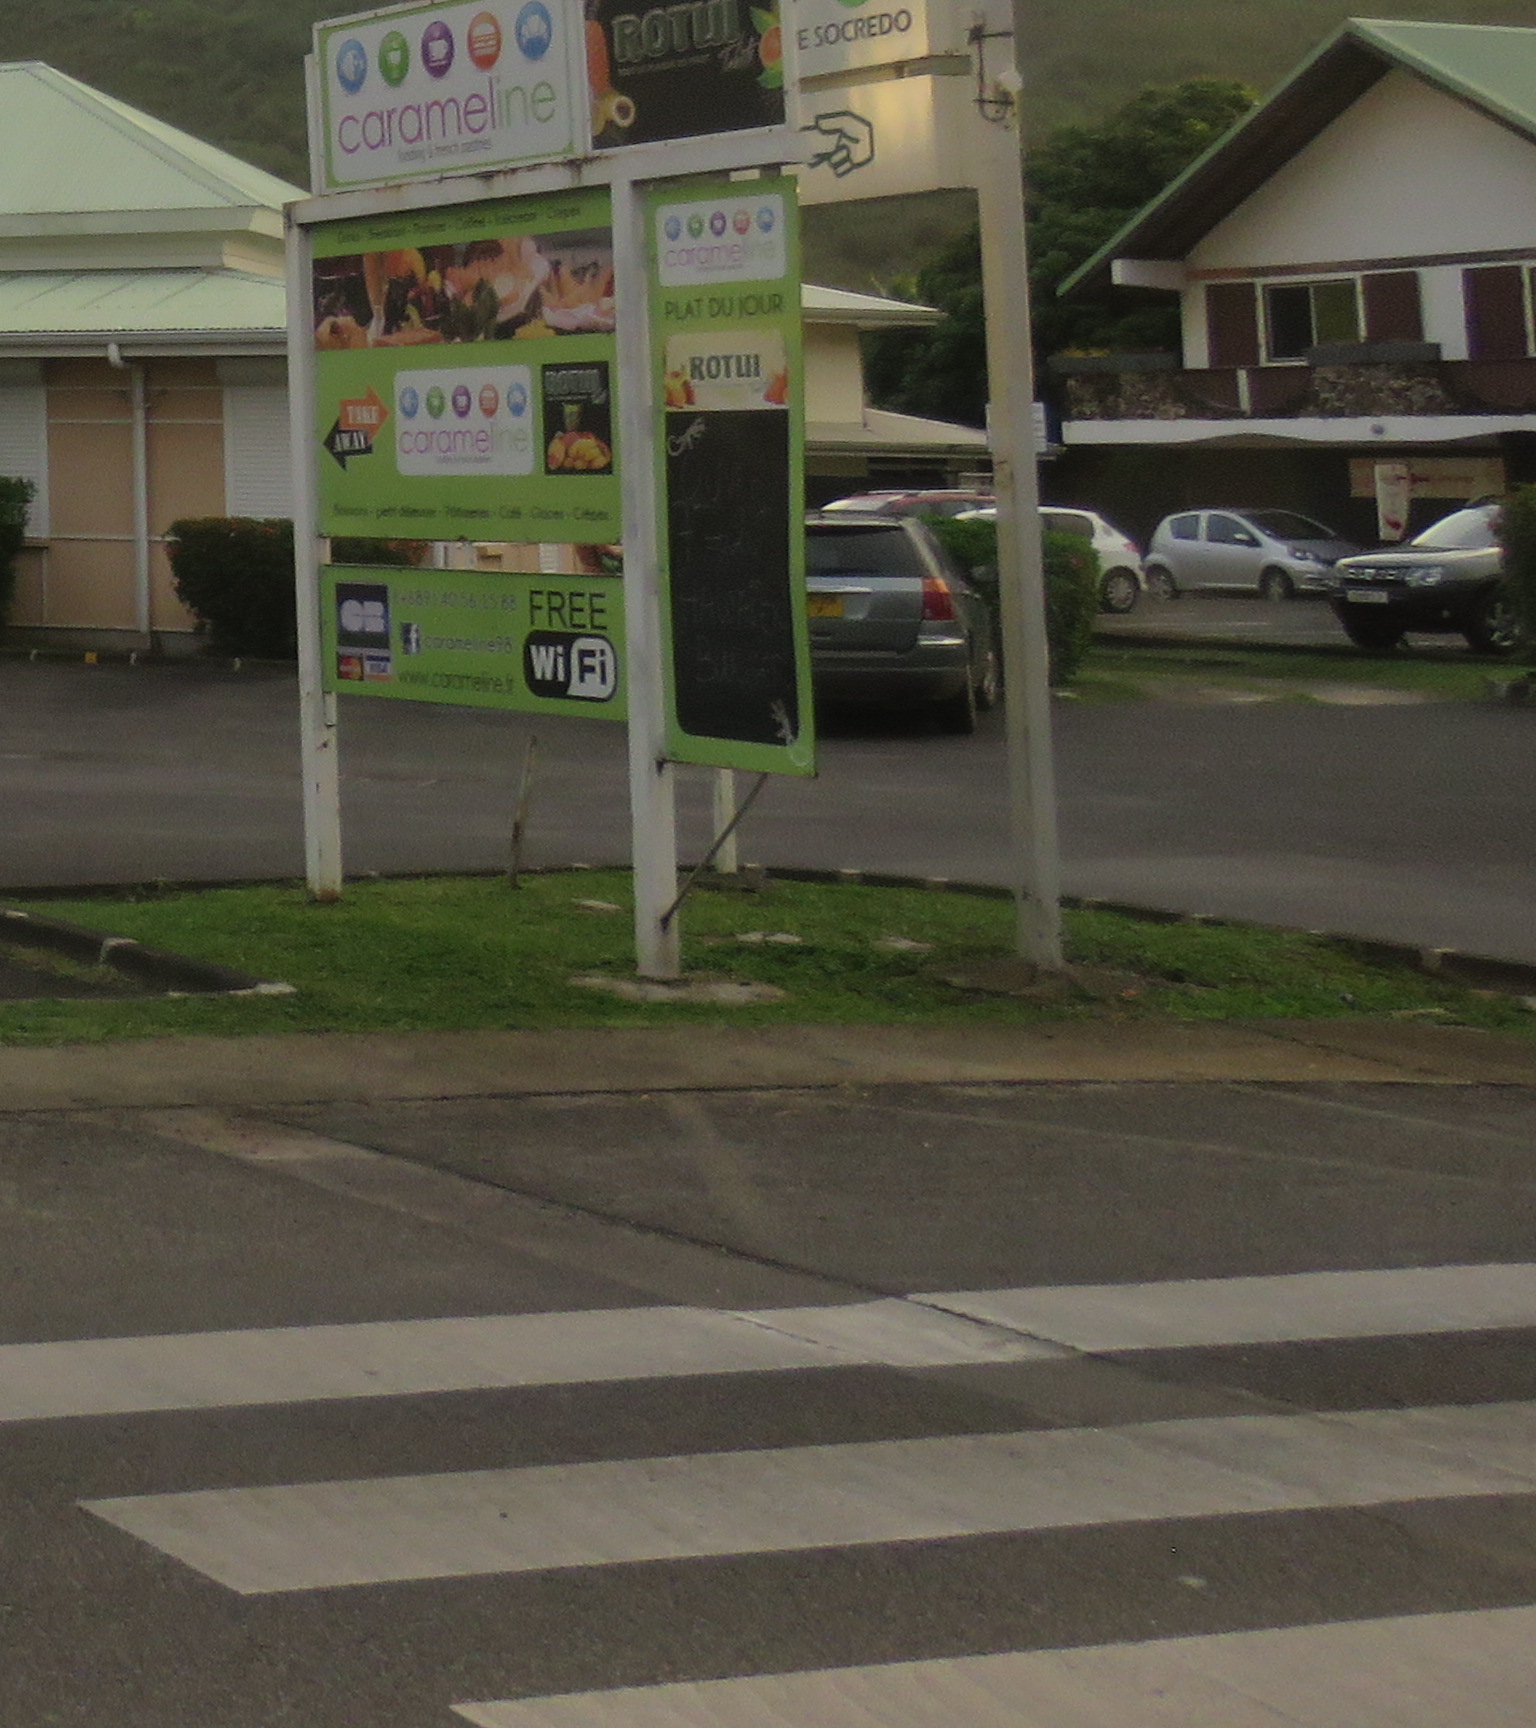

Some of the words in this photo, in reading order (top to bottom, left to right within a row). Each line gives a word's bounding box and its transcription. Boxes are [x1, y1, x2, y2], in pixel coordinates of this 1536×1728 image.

[814, 8, 913, 48] SOCREDO
[339, 75, 557, 154] carameline
[664, 298, 705, 319] PLAT
[709, 296, 733, 318] DU
[738, 293, 784, 319] JOUR
[690, 353, 761, 380] ROTUI
[334, 431, 368, 452] AWAY
[399, 420, 528, 455] carameline
[529, 589, 609, 630] FREE
